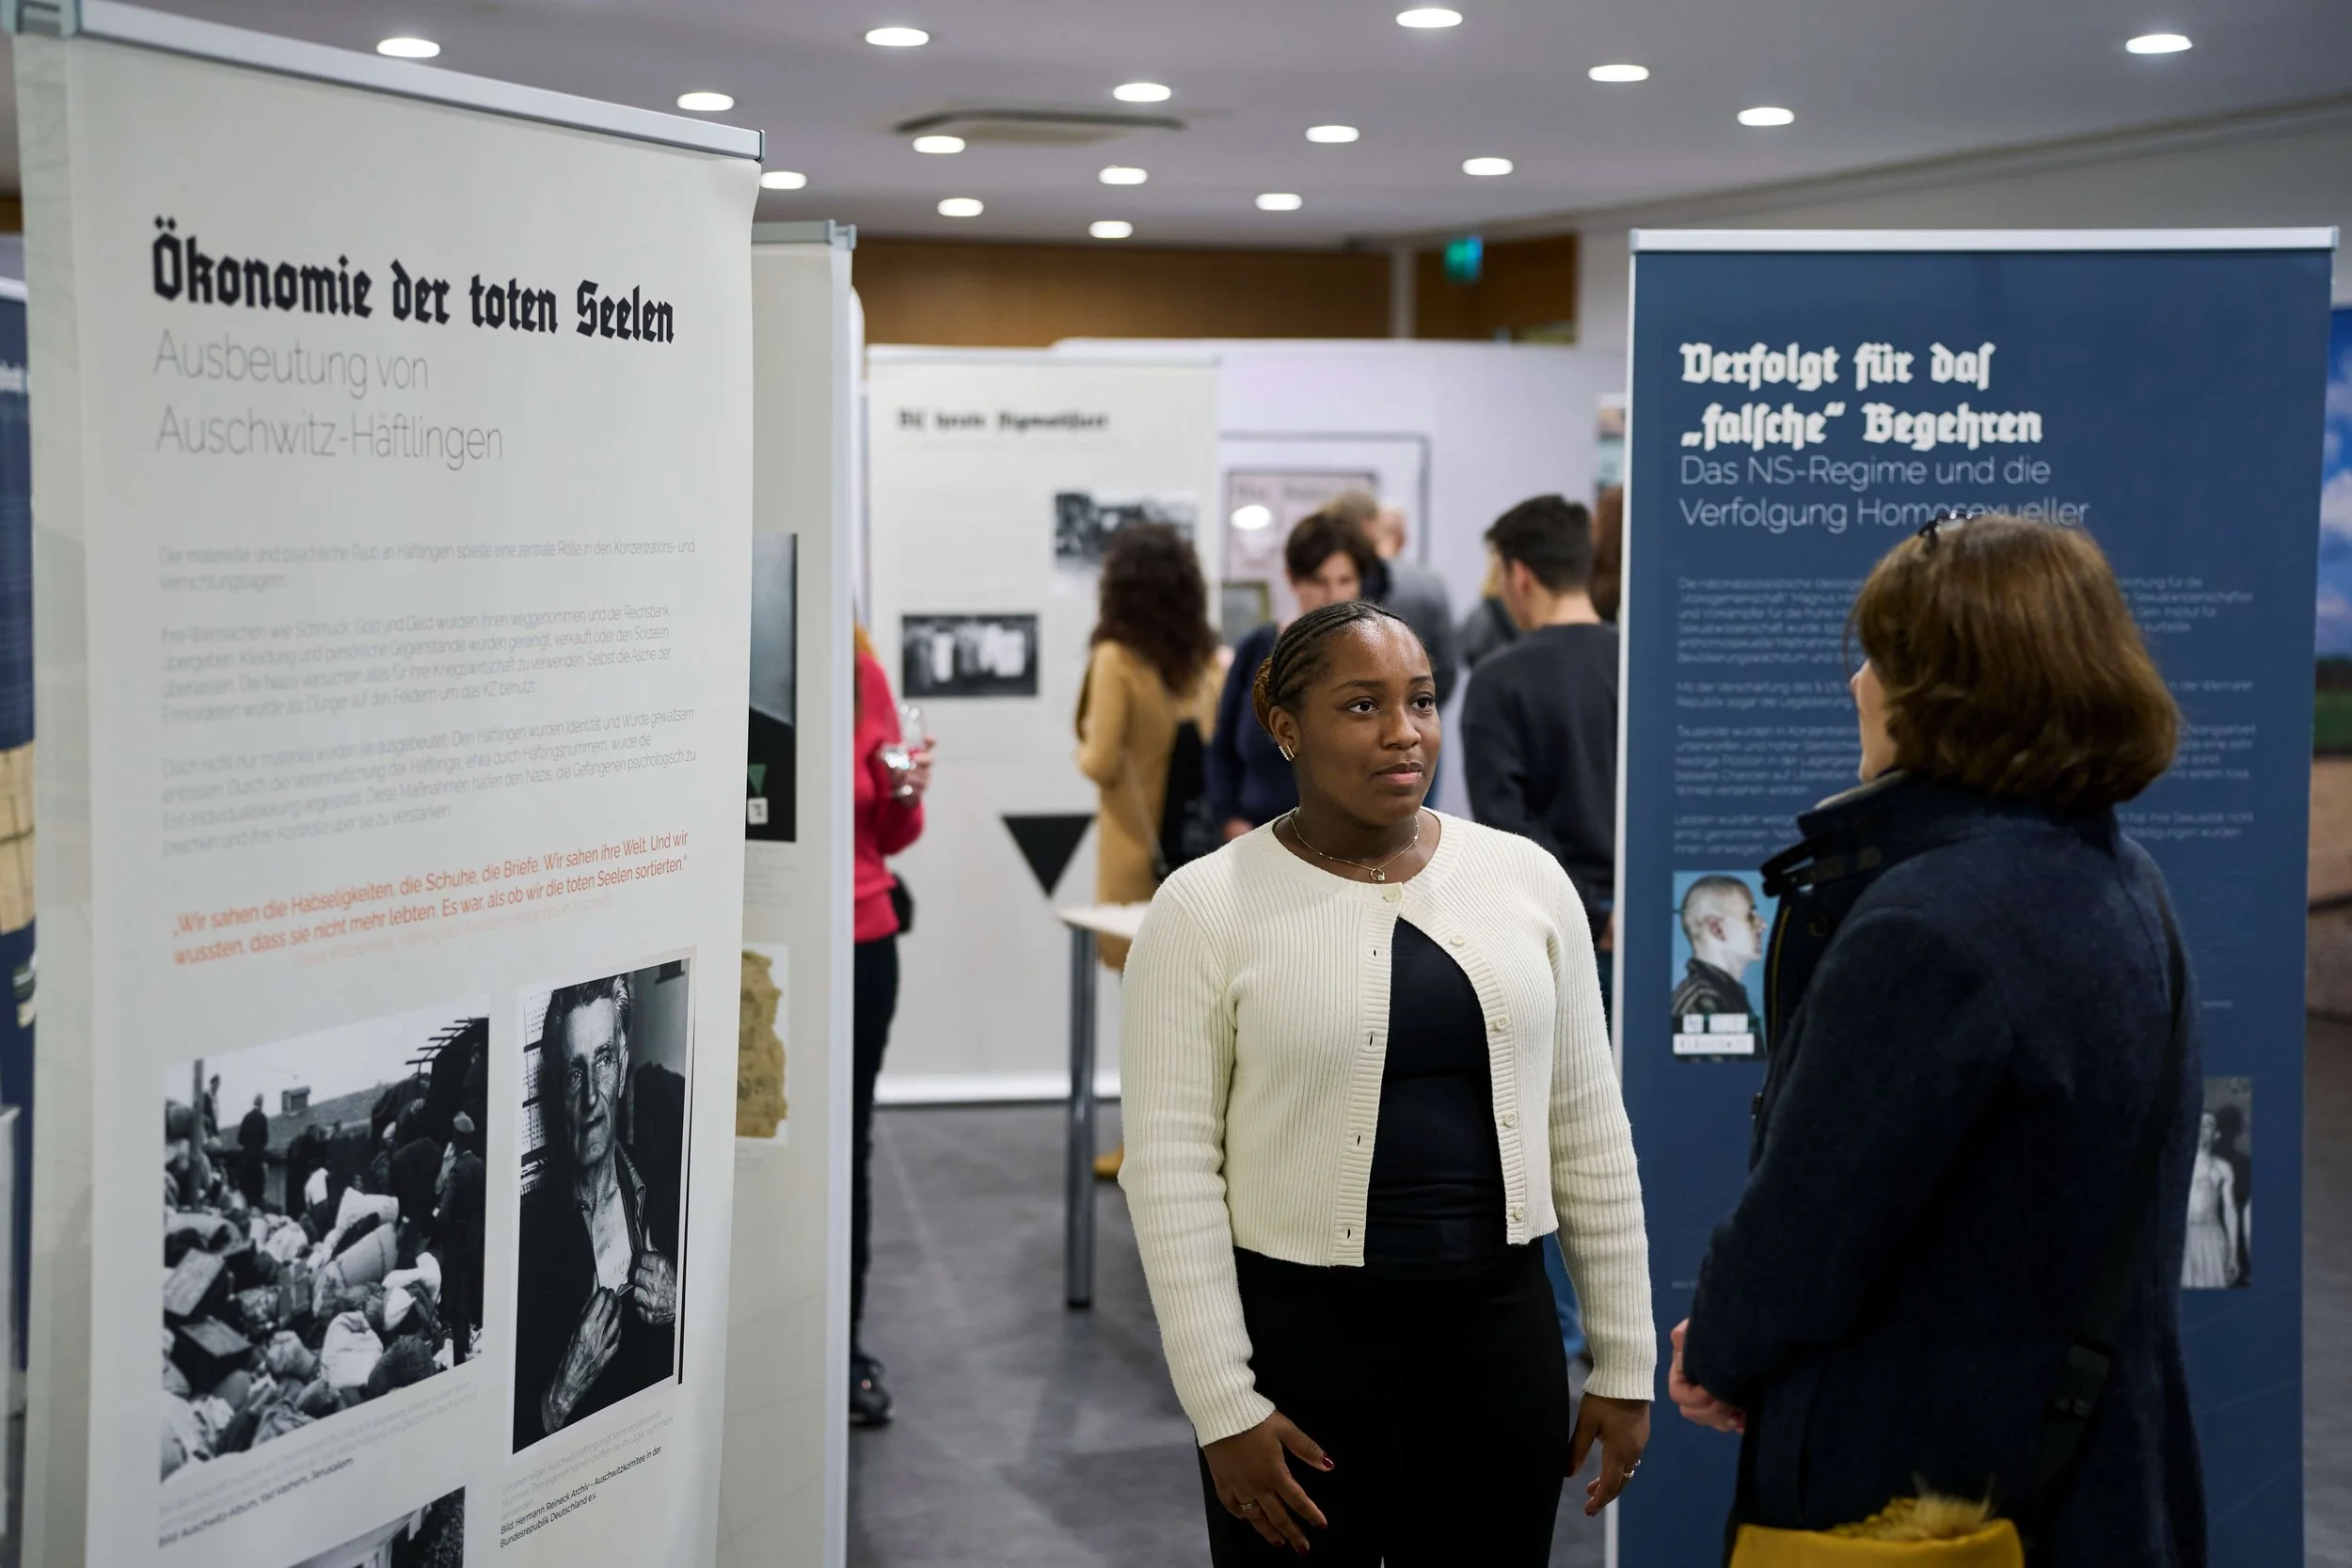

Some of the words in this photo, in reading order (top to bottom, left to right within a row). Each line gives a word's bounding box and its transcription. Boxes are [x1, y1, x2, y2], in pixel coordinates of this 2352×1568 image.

[151, 215, 373, 319] Ökonomie
[391, 259, 451, 325] der
[469, 274, 559, 335] toten
[576, 278, 675, 344] Seelen
[154, 328, 368, 400] Ausbeutung
[376, 353, 428, 389] von
[1679, 342, 1839, 391] Verfolgt
[1852, 342, 1914, 391] für
[156, 404, 502, 470] Auschwitz-Häftlingen
[1861, 402, 2042, 451] Begehren
[1681, 455, 1740, 484] Das
[1748, 455, 1927, 492] NS-Regime
[1935, 455, 1995, 485] und
[2003, 455, 2051, 485] die
[1679, 498, 1848, 534] Verfolgung
[494, 545, 516, 558] eine
[518, 543, 555, 557] zentrale
[558, 540, 581, 556] Rolle
[593, 542, 611, 555] den
[614, 541, 675, 554] Konzentrations-
[677, 539, 694, 552] und
[405, 615, 433, 631] Geld
[435, 615, 478, 629] wurden
[482, 614, 508, 626] ihnen
[510, 610, 585, 629] weggenommen
[587, 610, 606, 622] und
[608, 609, 622, 621] der
[625, 605, 669, 619] Reichsbank
[468, 637, 506, 651] wurden
[554, 628, 593, 645] verkauft
[595, 631, 614, 643] oder
[616, 628, 632, 641] den
[635, 626, 668, 640] Soldaten
[516, 658, 529, 672] zu
[587, 651, 614, 666] Selbst
[616, 648, 628, 663] die
[629, 648, 656, 661] Asche
[658, 647, 670, 660] der
[438, 688, 458, 701] um
[461, 686, 480, 699] das
[483, 680, 497, 697] KZ
[452, 730, 474, 747] Den
[476, 727, 525, 744] Häftlingen
[527, 722, 563, 737] wurden
[566, 716, 600, 734] Identität
[603, 715, 619, 730] und
[623, 713, 647, 727] Würde
[650, 708, 693, 728] gewaltsam
[466, 753, 491, 768] etwa
[494, 747, 521, 766] durch
[611, 736, 636, 750] wurde
[638, 733, 650, 747] die
[399, 780, 469, 798] Maßnahmen
[472, 774, 501, 790] halfen
[505, 772, 523, 786] den
[555, 762, 570, 780] die
[573, 760, 625, 777] Gefangenen
[628, 749, 683, 771] psychologisch
[685, 751, 695, 761] zu
[211, 908, 258, 928] sahen
[262, 900, 287, 920] die
[399, 878, 421, 895] die
[425, 870, 479, 891] Schuhe,
[482, 865, 501, 882] die
[544, 853, 563, 870] Wir
[566, 850, 597, 866] sahen
[600, 844, 620, 860] ihre
[623, 838, 647, 855] Welt.
[650, 832, 670, 850] Und
[672, 831, 688, 847] wir
[249, 933, 286, 952] dass
[290, 928, 310, 945] sie
[312, 919, 346, 938] nicht
[350, 912, 385, 931] mehr
[389, 906, 438, 925] lebten.
[442, 898, 457, 916] Es
[487, 891, 504, 908] als
[508, 886, 523, 904] ob
[526, 882, 544, 900] wir
[546, 880, 563, 896] die
[566, 876, 594, 893] toten
[596, 868, 632, 886] Seelen
[516, 1506, 545, 1527] Hermann
[546, 1493, 570, 1513] Reineck
[570, 1481, 590, 1499] Archiv
[594, 1454, 646, 1486] Auschwitzkomitee
[646, 1450, 652, 1459] in
[652, 1446, 662, 1457] der
[500, 1515, 549, 1548] Bundesrepublik
[550, 1495, 588, 1522] Deutschland
